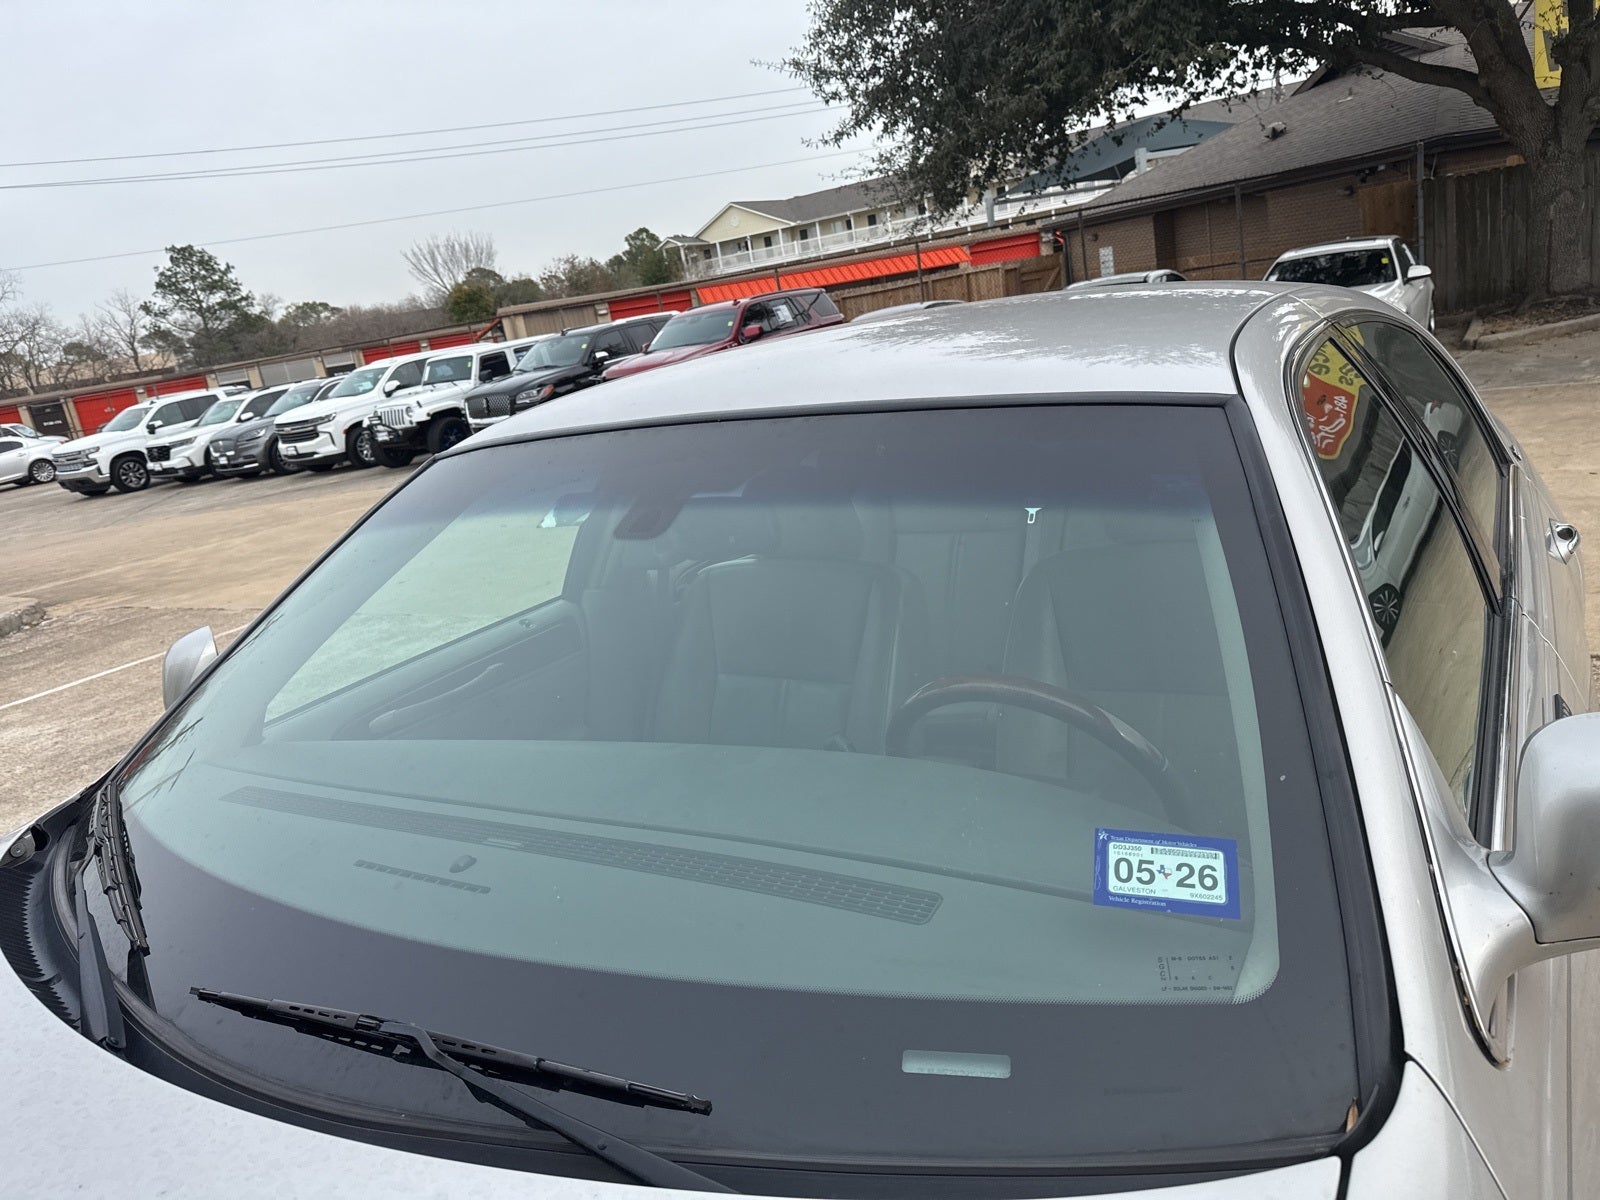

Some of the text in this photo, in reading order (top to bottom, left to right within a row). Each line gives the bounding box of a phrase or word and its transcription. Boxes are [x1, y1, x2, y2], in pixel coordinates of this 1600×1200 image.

[1123, 836, 1153, 844] Department
[1114, 857, 1218, 891] 05 26
[1113, 885, 1155, 894] GALVESTON
[1131, 897, 1166, 907] Registration
